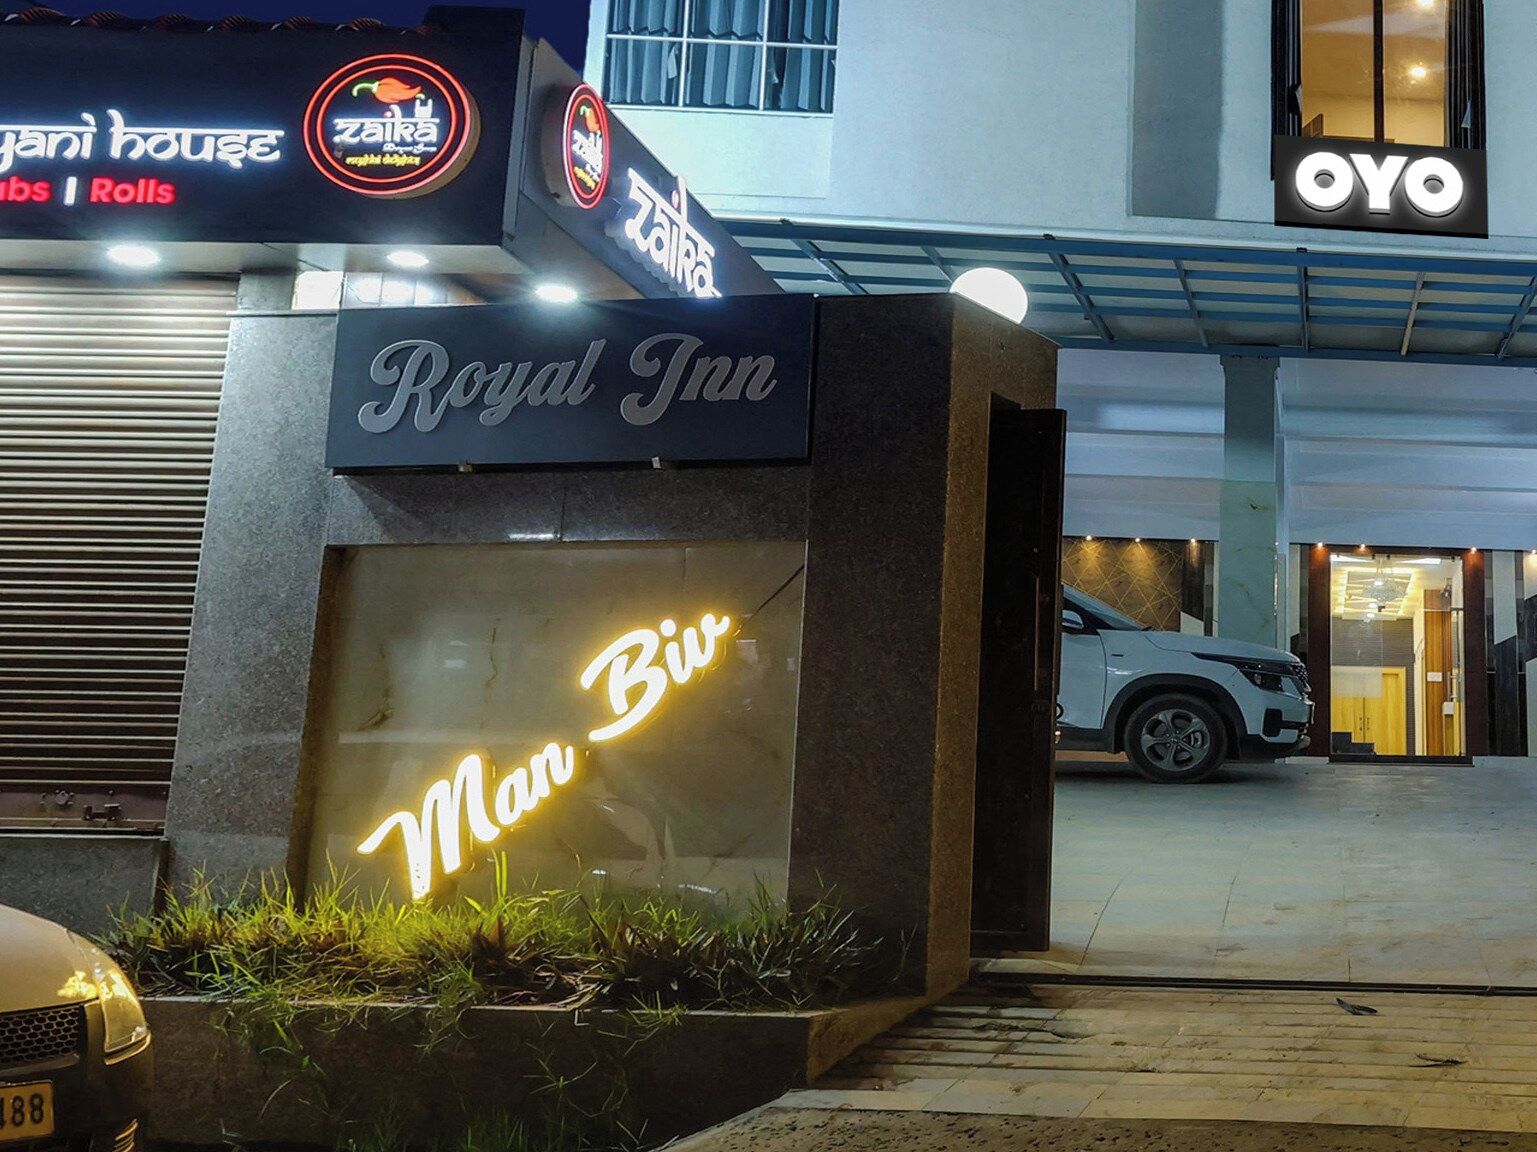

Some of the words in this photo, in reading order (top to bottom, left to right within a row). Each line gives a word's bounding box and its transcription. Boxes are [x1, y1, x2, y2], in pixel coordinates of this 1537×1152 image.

[106, 109, 285, 169] house
[89, 176, 176, 205] Rolls
[1295, 151, 1464, 217] OYO
[357, 338, 607, 434] Royal
[620, 332, 778, 426] Inn
[356, 741, 575, 900] Man
